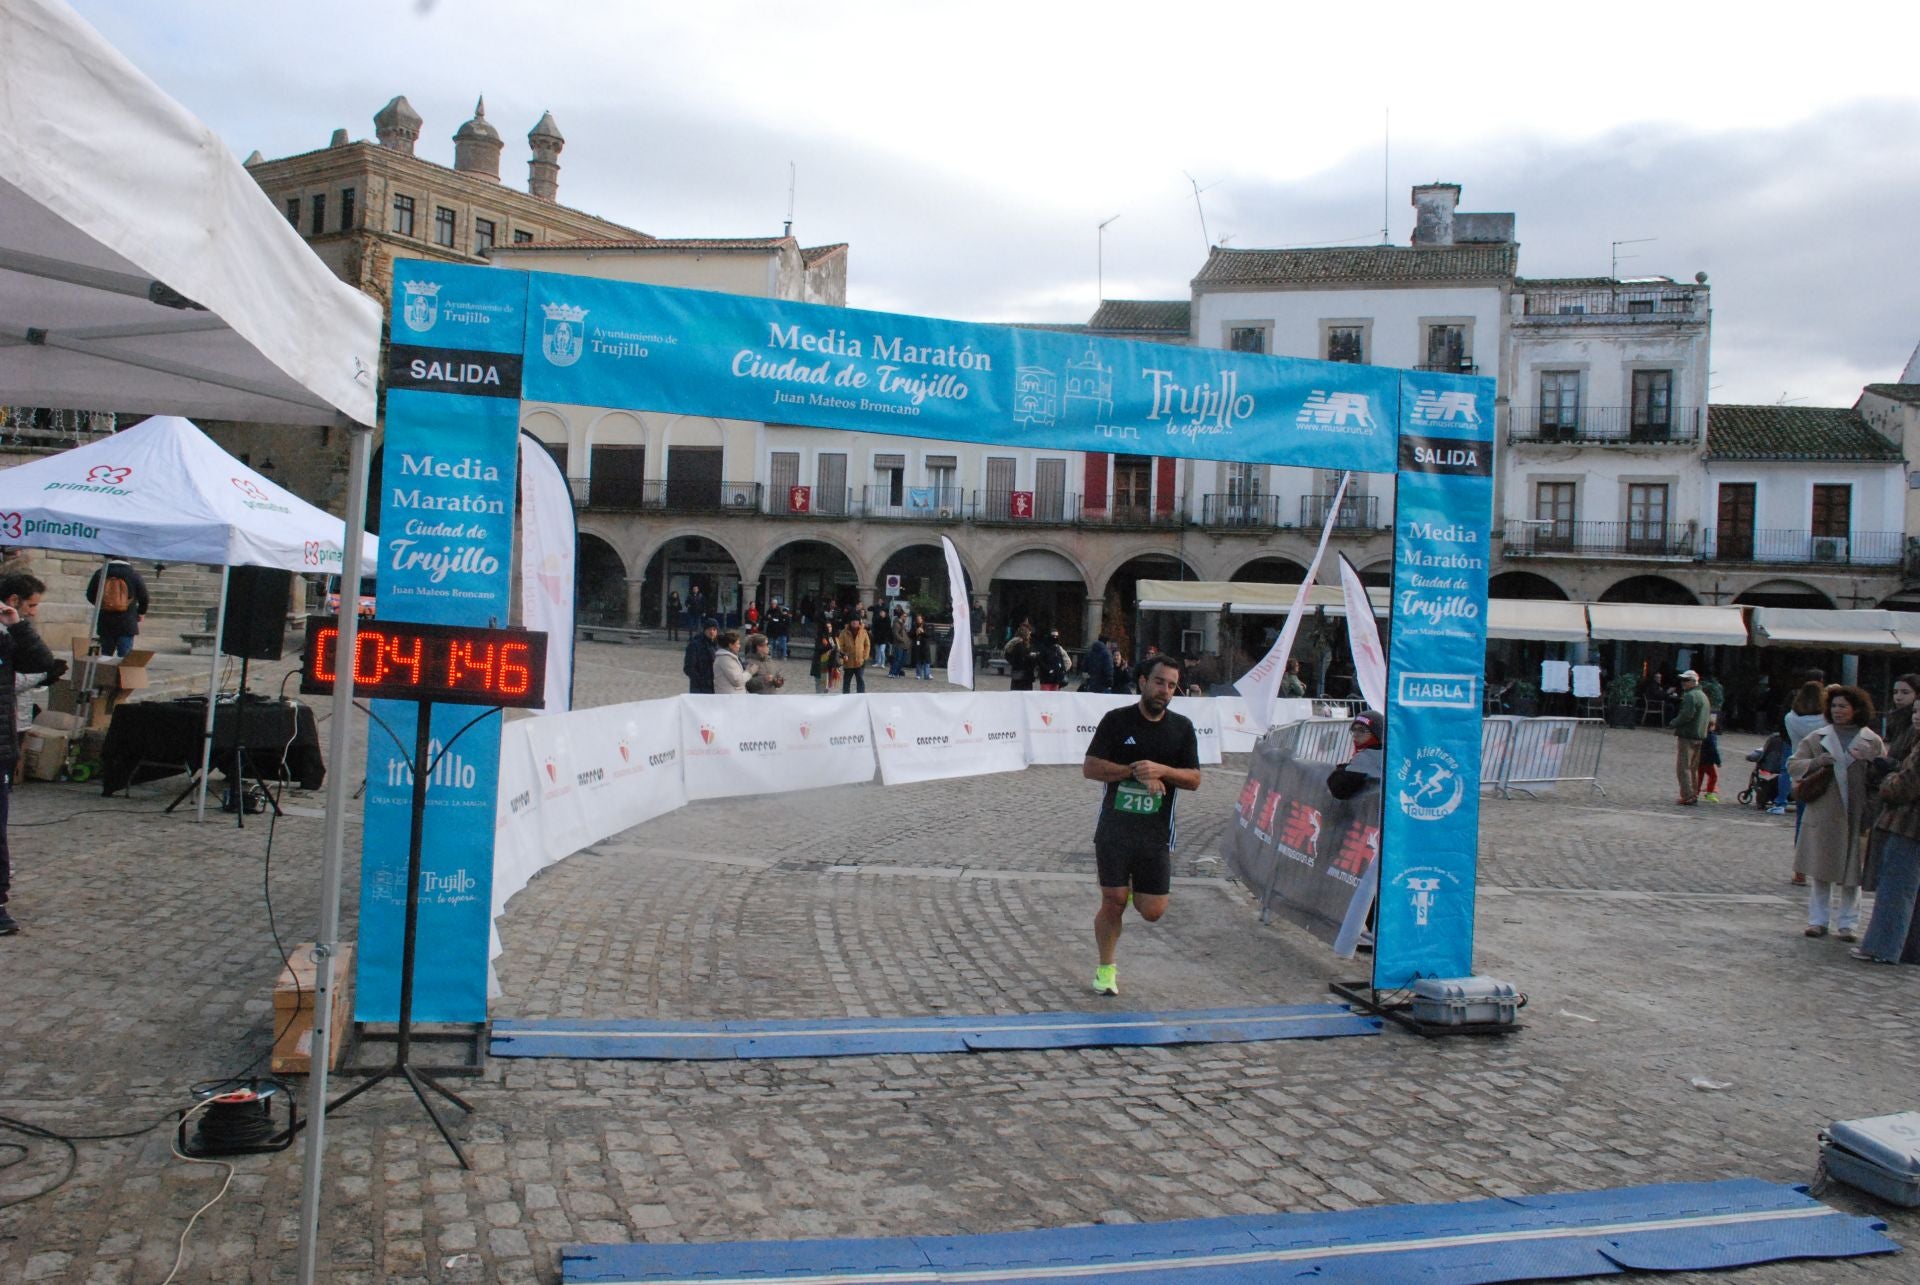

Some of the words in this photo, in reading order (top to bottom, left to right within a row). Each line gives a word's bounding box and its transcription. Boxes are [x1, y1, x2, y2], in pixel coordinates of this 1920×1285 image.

[445, 300, 503, 312] Ayuntamiento
[504, 304, 514, 313] de
[443, 310, 490, 326] Trujillo
[593, 327, 665, 344] Ayuntamiento
[666, 335, 679, 346] de
[767, 322, 863, 358] Media
[871, 335, 993, 372] Maratón
[591, 339, 649, 360] Trujillo
[410, 358, 500, 386] SALIDA
[732, 349, 831, 385] Ciudad
[834, 363, 869, 389] de
[876, 365, 969, 405] Trujillo
[773, 389, 806, 405] Juan
[809, 392, 857, 410] Mateos
[860, 398, 921, 417] Broncano
[1142, 367, 1255, 430] Trujillo
[1166, 416, 1179, 435] te
[1295, 423, 1374, 436] www.musicrun.es
[1414, 446, 1478, 467] SALIDA
[400, 453, 499, 482] Media
[44, 482, 133, 496] primaflor
[392, 488, 504, 515] Maratón
[24, 519, 101, 539] primaflor
[405, 518, 464, 538] Ciudad
[466, 524, 488, 540] de
[1409, 521, 1478, 543] Media
[389, 539, 499, 583] Trujillo
[1404, 549, 1483, 570] Maratón
[392, 585, 414, 596] Juan
[416, 586, 450, 598] Mateos
[452, 588, 495, 599] Broncano
[1411, 573, 1452, 589] Ciudad
[1453, 577, 1469, 590] de
[1401, 590, 1479, 625] Trujillo
[1409, 682, 1463, 698] HABLA
[1397, 757, 1411, 781] Club
[1416, 746, 1459, 769] Atletismo
[1123, 794, 1154, 812] 219
[1403, 803, 1449, 817] TRUJILLO
[421, 869, 476, 893] Trujillo
